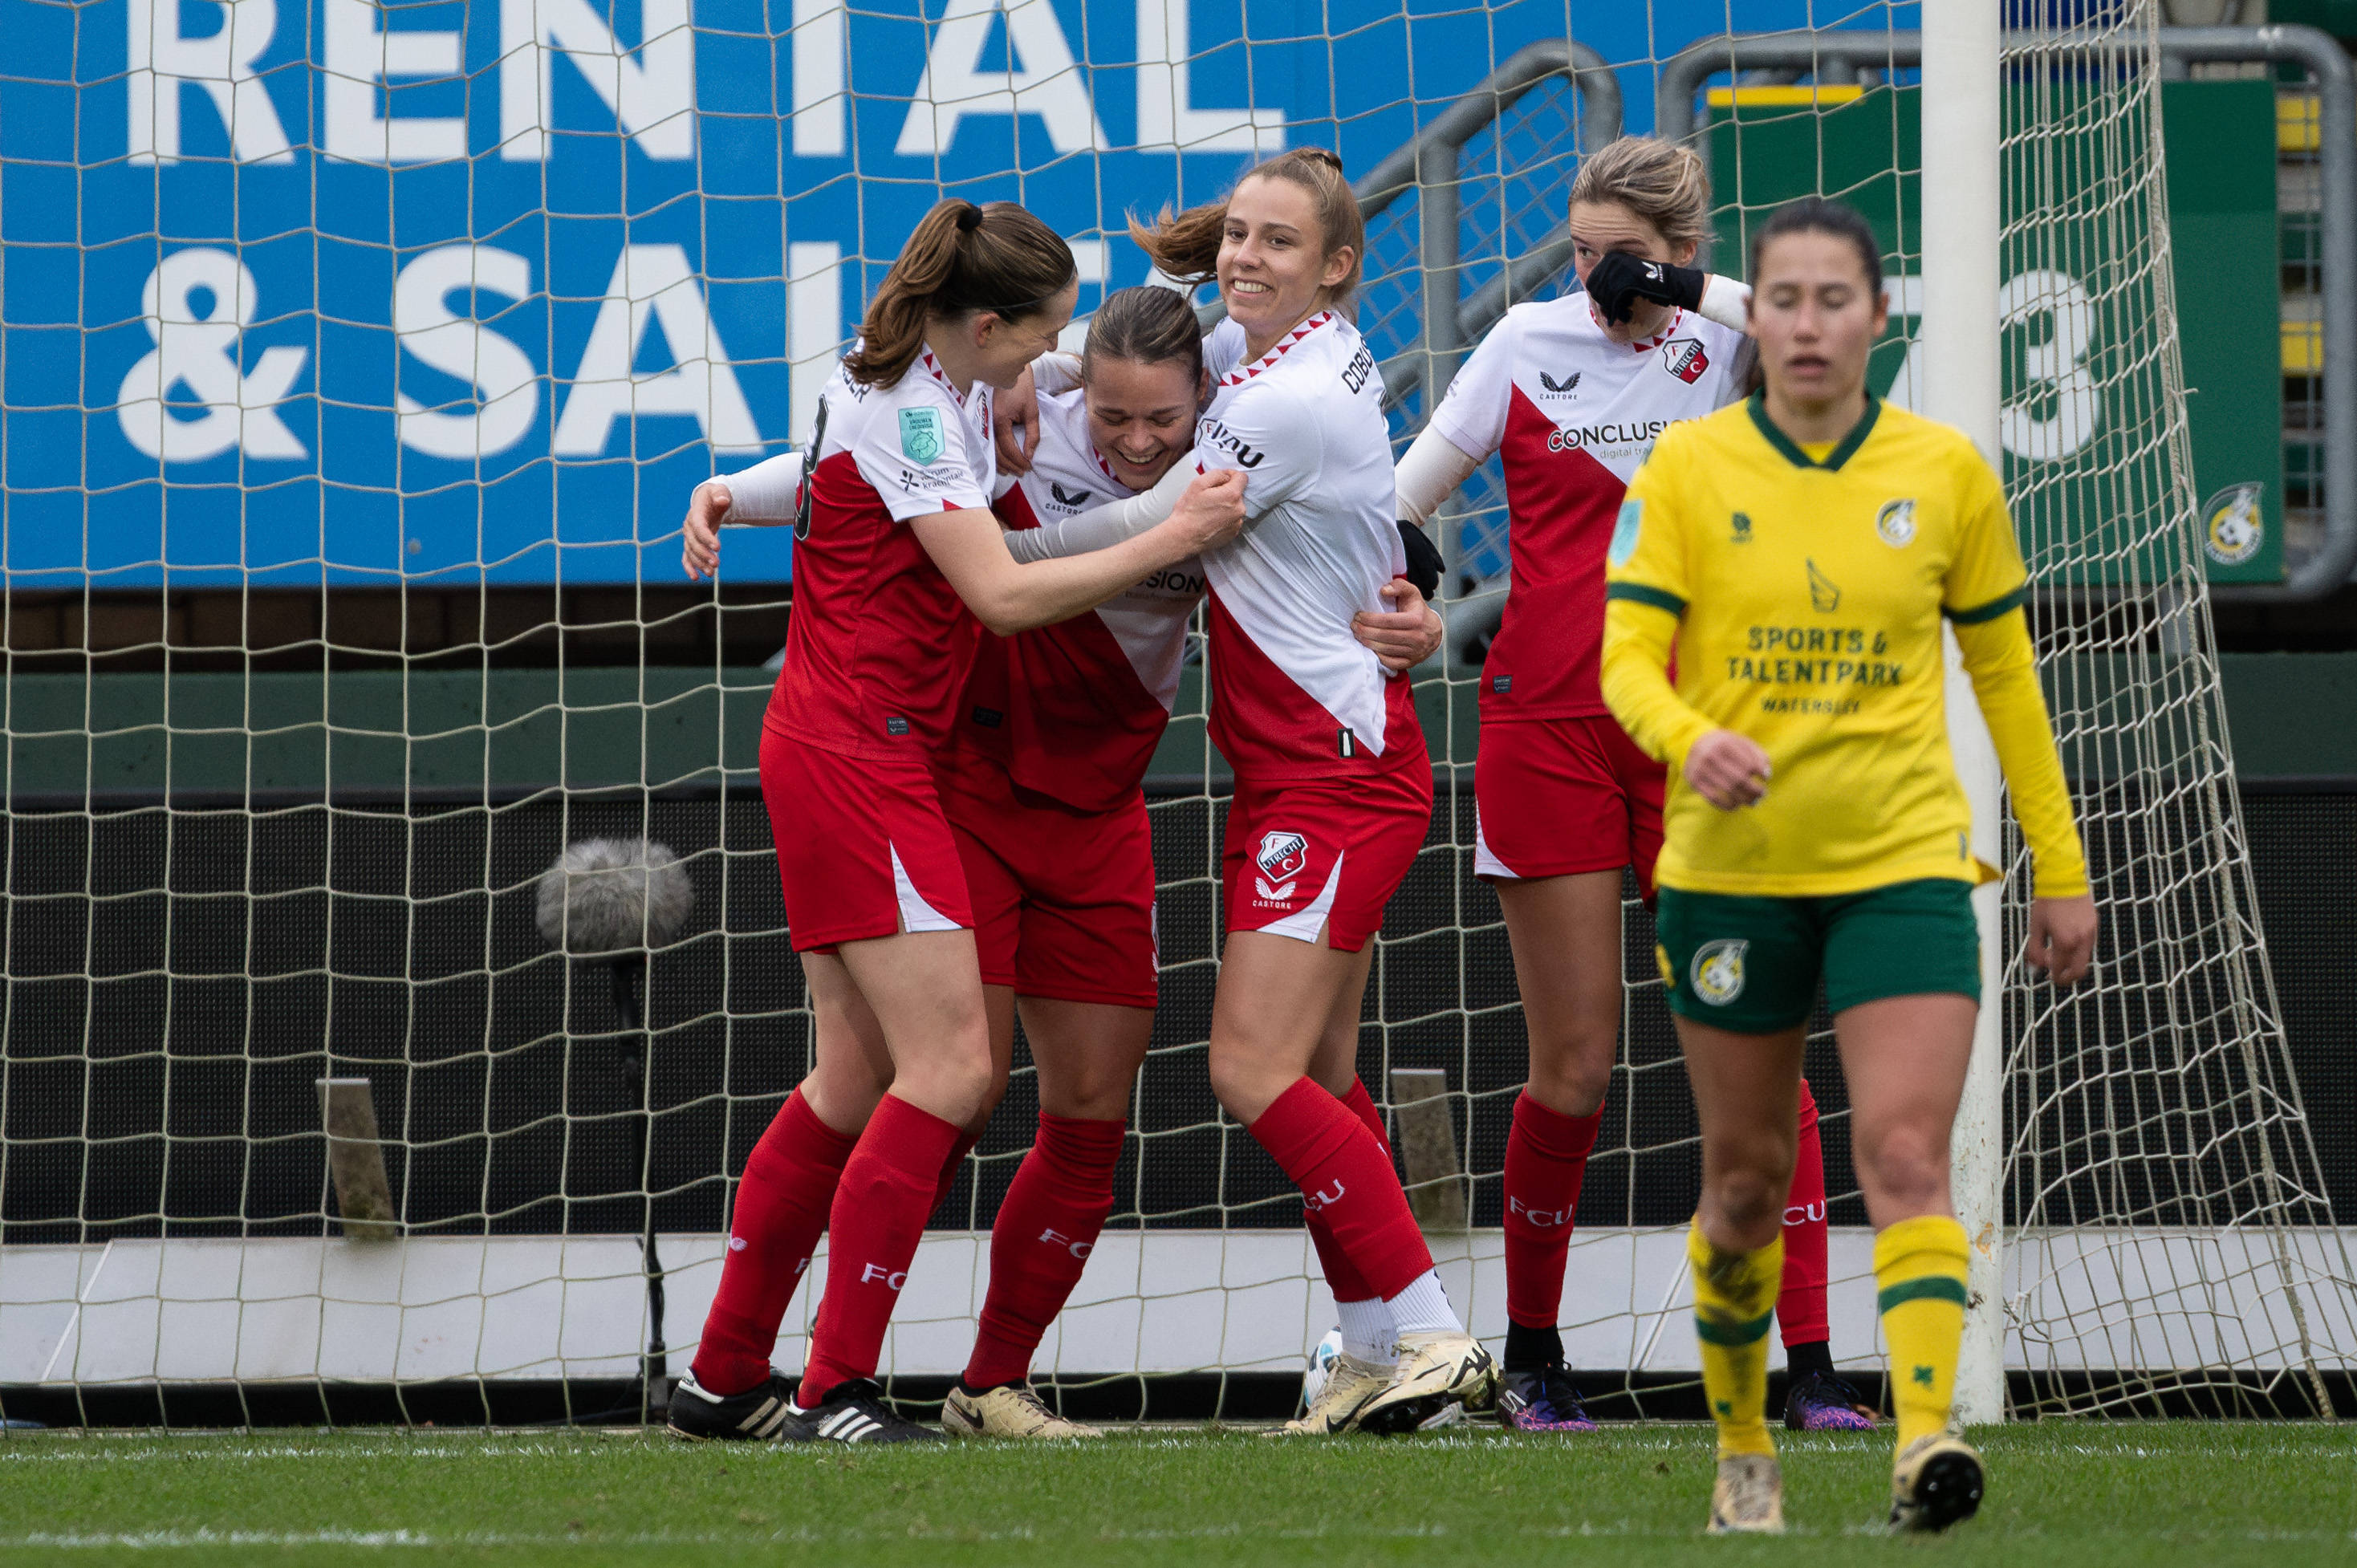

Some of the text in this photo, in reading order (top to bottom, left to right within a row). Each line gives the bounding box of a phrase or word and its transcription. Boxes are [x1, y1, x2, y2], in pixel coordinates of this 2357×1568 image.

[128, 0, 1285, 165] RENTAL
[117, 242, 1208, 463] & SAL
[1672, 341, 1702, 376] UTRECHT
[1547, 416, 1701, 453] CONCLUS
[1599, 446, 1632, 460] digital
[1045, 502, 1083, 516] CASTOR
[1138, 569, 1205, 593] SION
[1747, 626, 1864, 654] SPORTS
[1727, 656, 1904, 686] TALENTPARK
[1263, 839, 1302, 869] UTRECHT
[1252, 900, 1291, 910] CASTORE
[1510, 1195, 1573, 1227] FCU
